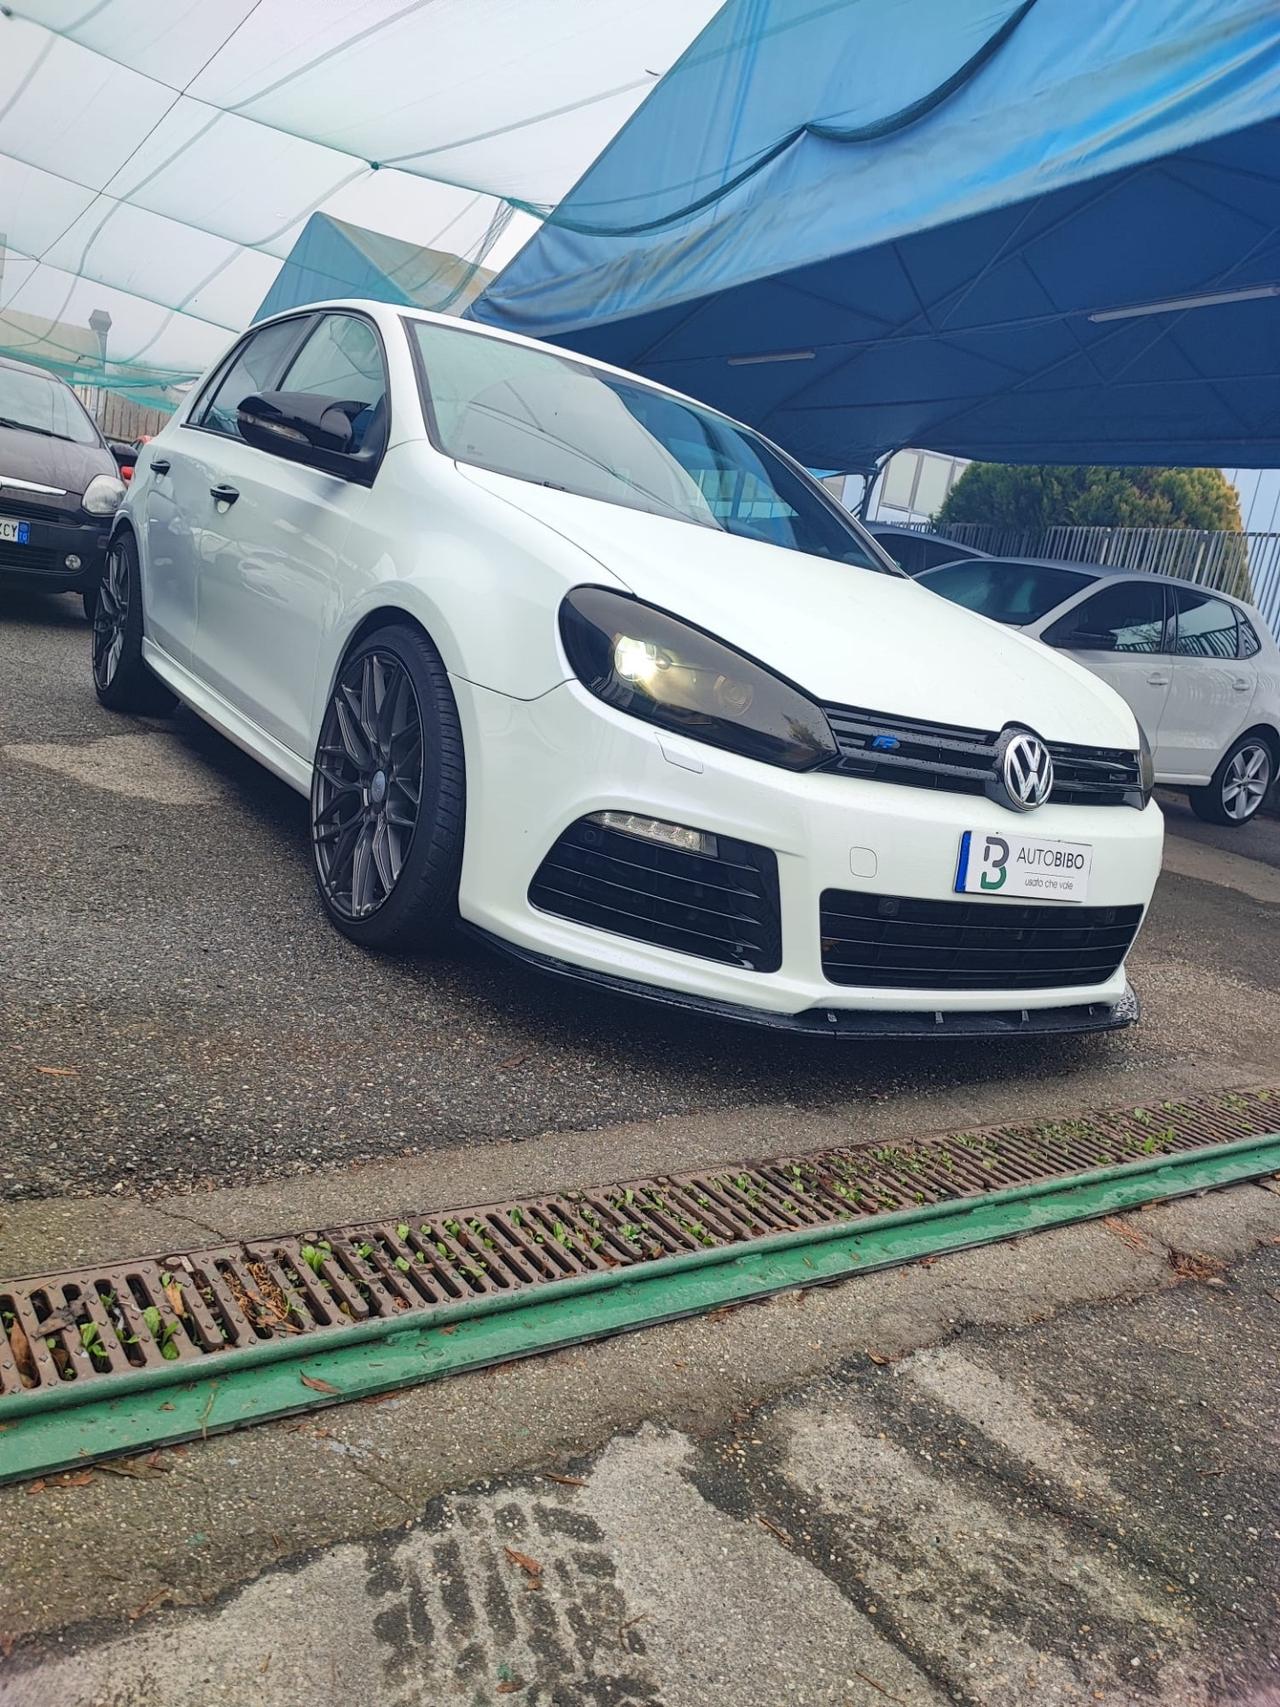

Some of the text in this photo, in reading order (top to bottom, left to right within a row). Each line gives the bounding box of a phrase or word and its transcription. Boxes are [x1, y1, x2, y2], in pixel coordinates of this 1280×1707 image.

[1005, 735, 1053, 810] VW
[1016, 847, 1085, 870] AUTOBIBO
[1024, 877, 1074, 891] usato che vale
